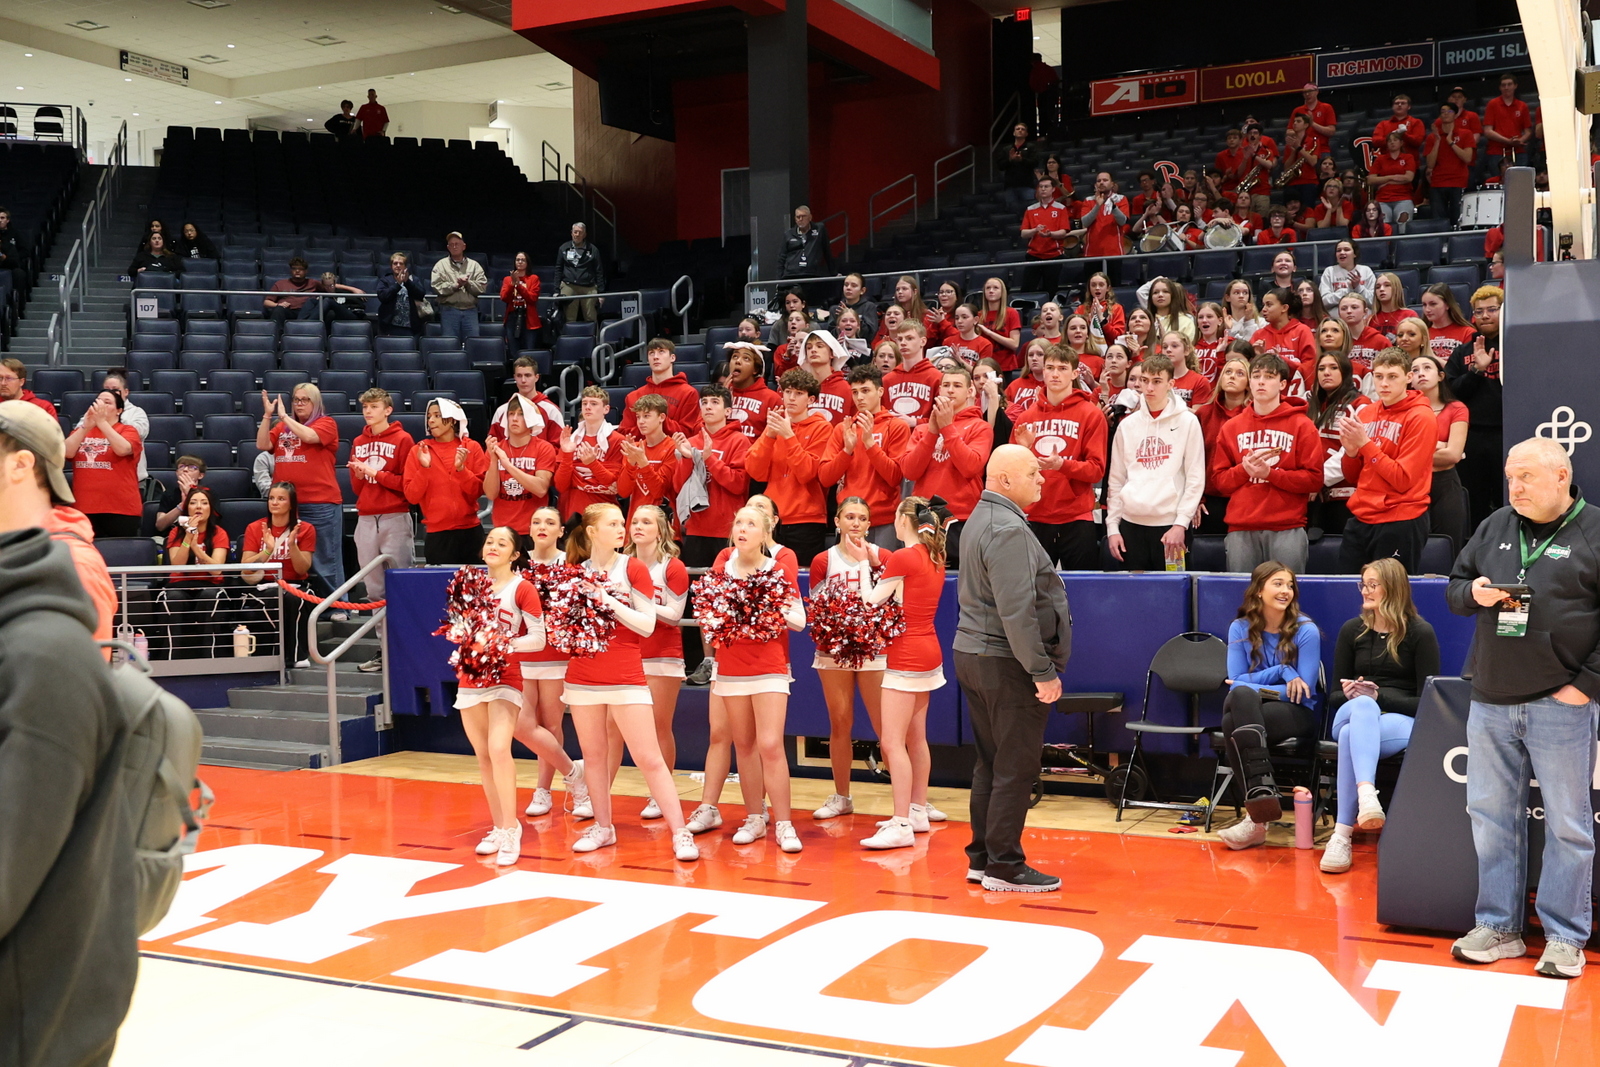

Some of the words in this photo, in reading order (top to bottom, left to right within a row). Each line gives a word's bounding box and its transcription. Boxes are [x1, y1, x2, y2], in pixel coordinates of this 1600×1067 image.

[1016, 9, 1030, 21] EXIT
[1446, 46, 1496, 65] RHODE
[1326, 53, 1424, 78] RICHMOND
[1225, 69, 1286, 89] LOYOLA
[139, 304, 155, 312] 107
[623, 306, 636, 314] 107
[752, 297, 766, 305] 108
[888, 381, 931, 402] BELLEVUE
[732, 396, 763, 414] LEVUE
[808, 393, 845, 413] EVUE
[1236, 428, 1295, 453] BELLEVUE
[355, 441, 397, 459] BELLEVUE
[1135, 444, 1173, 459] BELLEVUE
